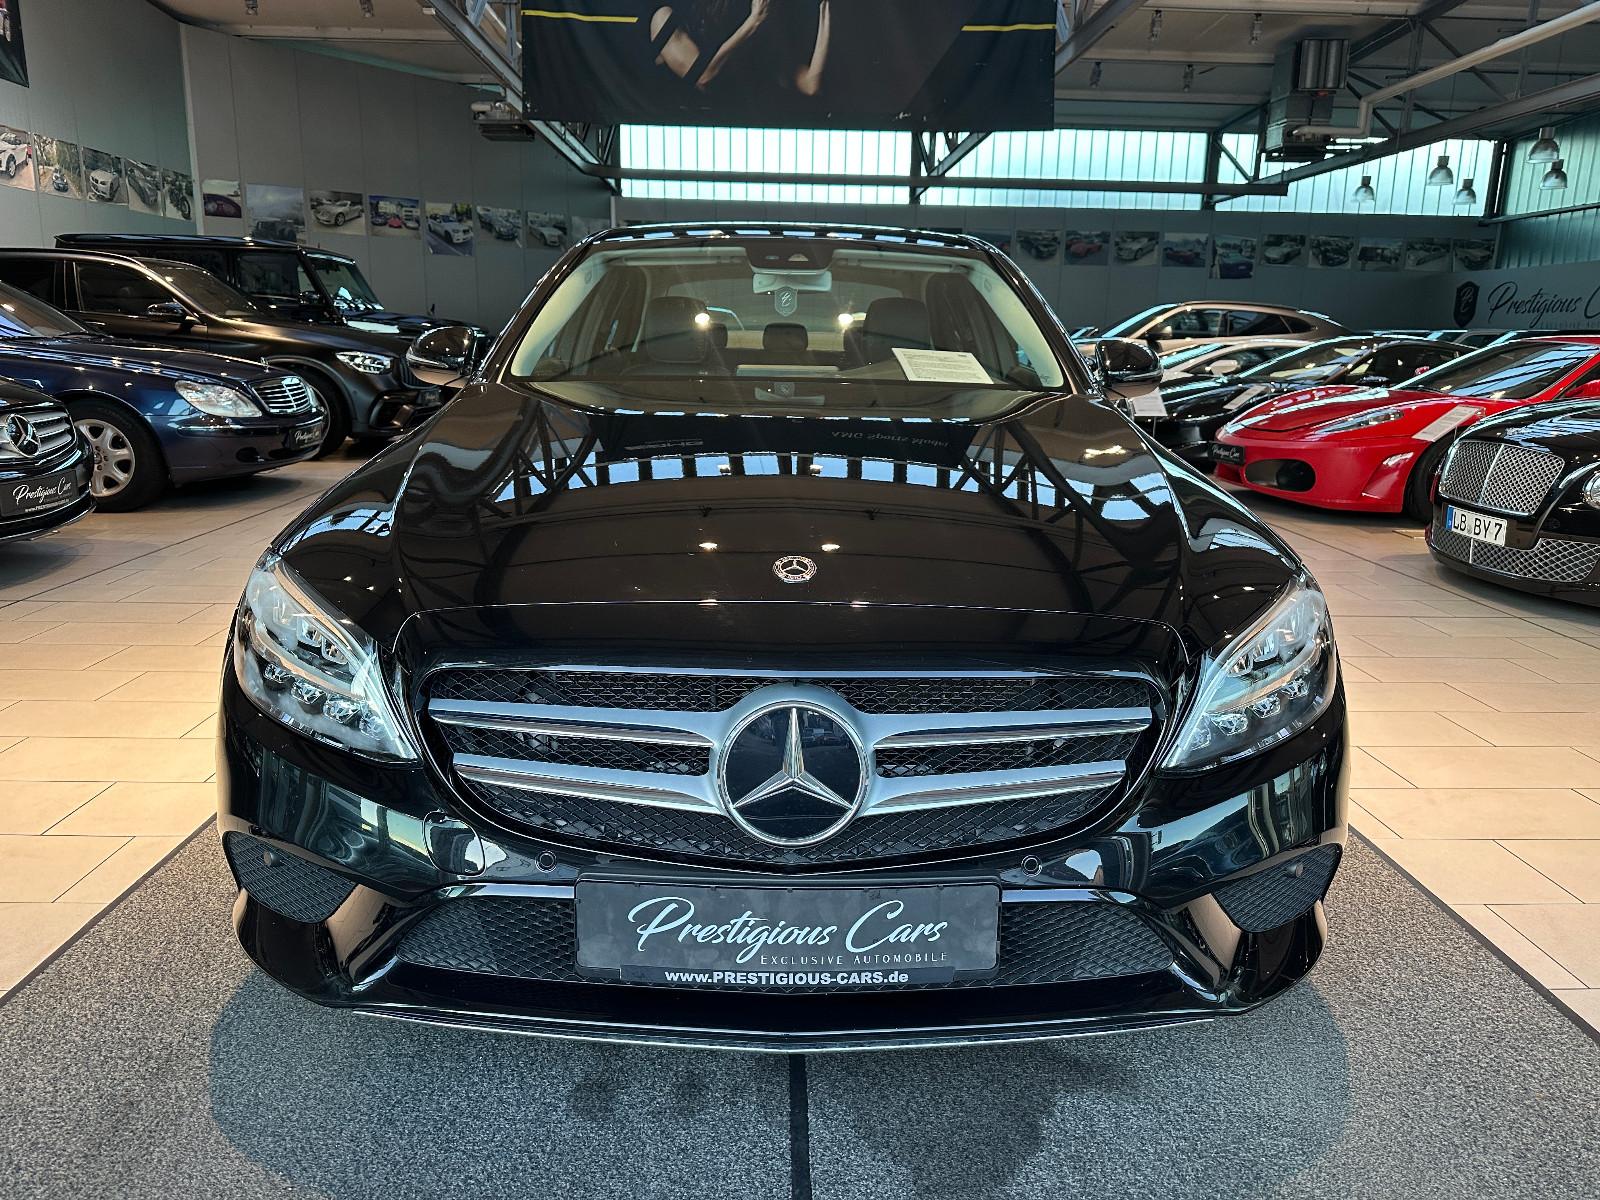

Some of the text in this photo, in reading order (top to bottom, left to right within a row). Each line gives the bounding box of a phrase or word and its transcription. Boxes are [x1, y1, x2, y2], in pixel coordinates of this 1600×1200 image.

[1487, 281, 1582, 328] Prestigious
[1453, 511, 1467, 532] LB
[627, 896, 949, 964] Prestigious Cars
[760, 952, 948, 965] EXCLUSIVE AUTOMOBILE
[664, 971, 910, 985] www.PRESTIGIOUS-CARS.de
